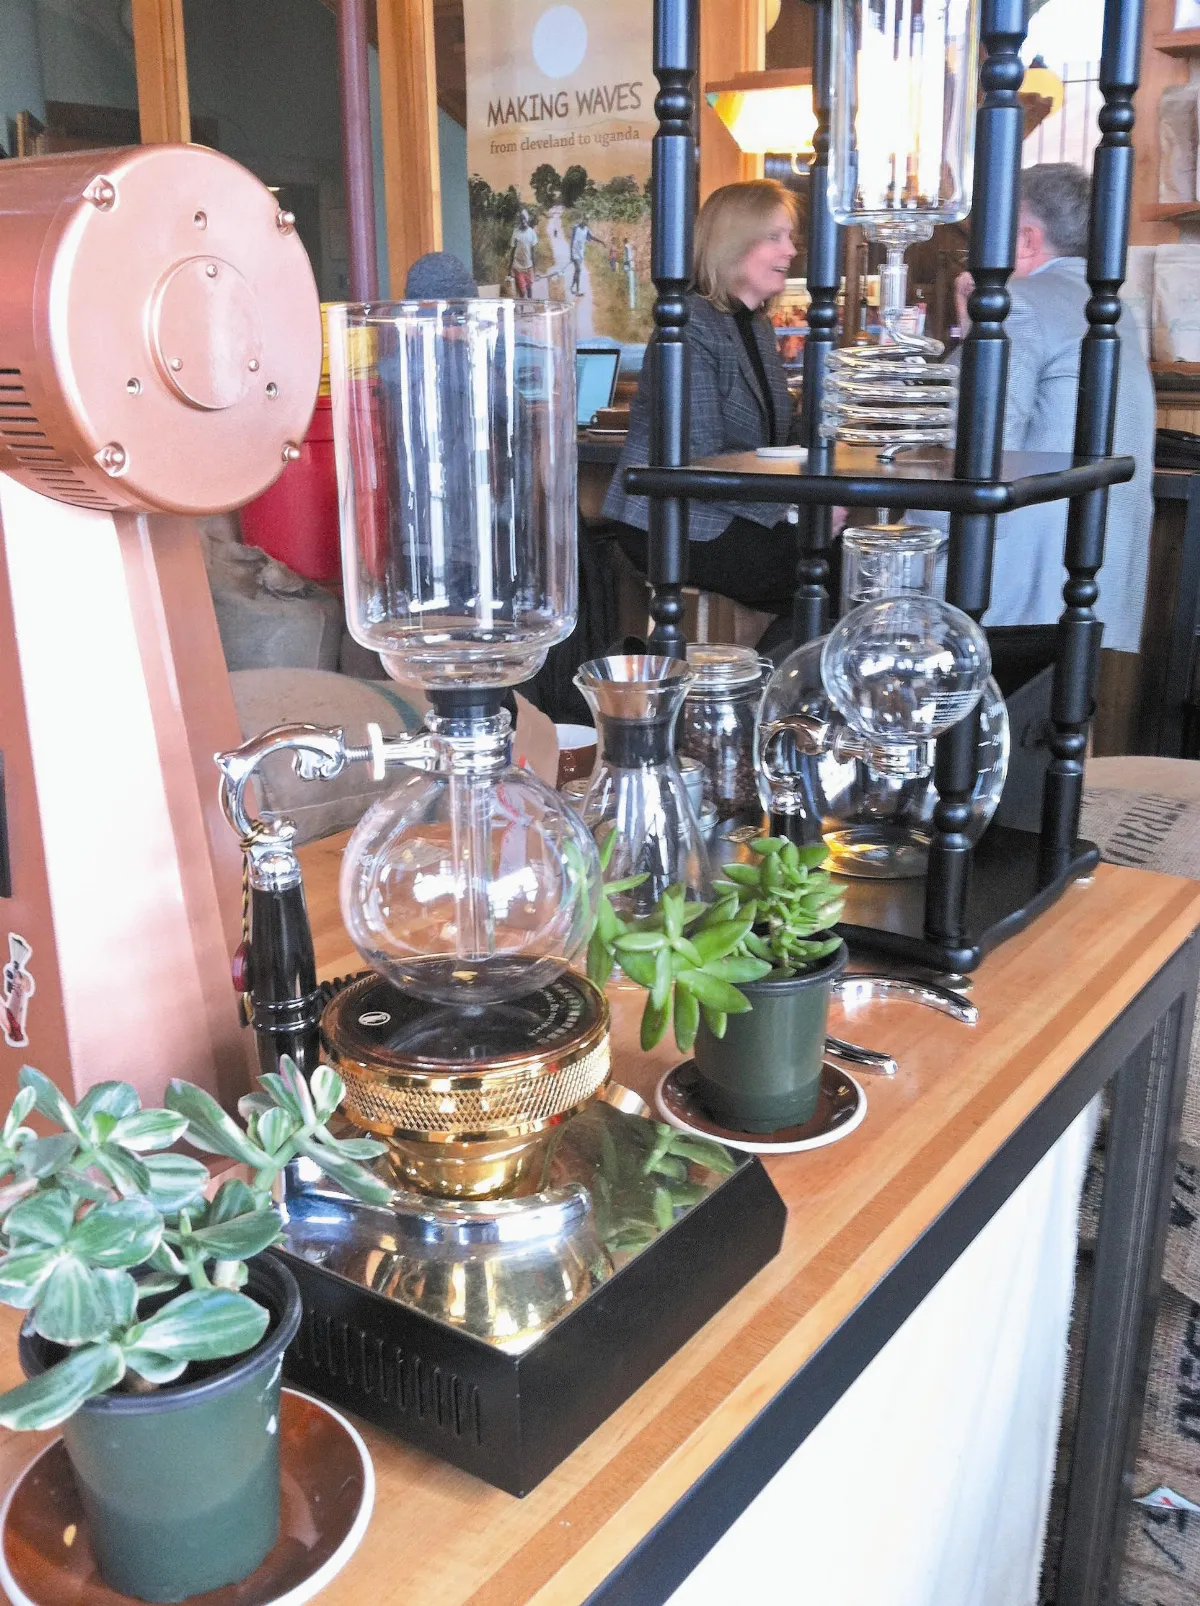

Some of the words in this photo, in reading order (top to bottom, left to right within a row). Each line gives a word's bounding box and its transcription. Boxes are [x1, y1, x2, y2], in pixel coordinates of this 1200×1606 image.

[487, 91, 569, 127] MAKING
[575, 82, 643, 116] WAVES
[490, 140, 517, 154] from
[520, 132, 575, 151] cleveland
[578, 134, 591, 145] to
[594, 126, 640, 147] uganda
